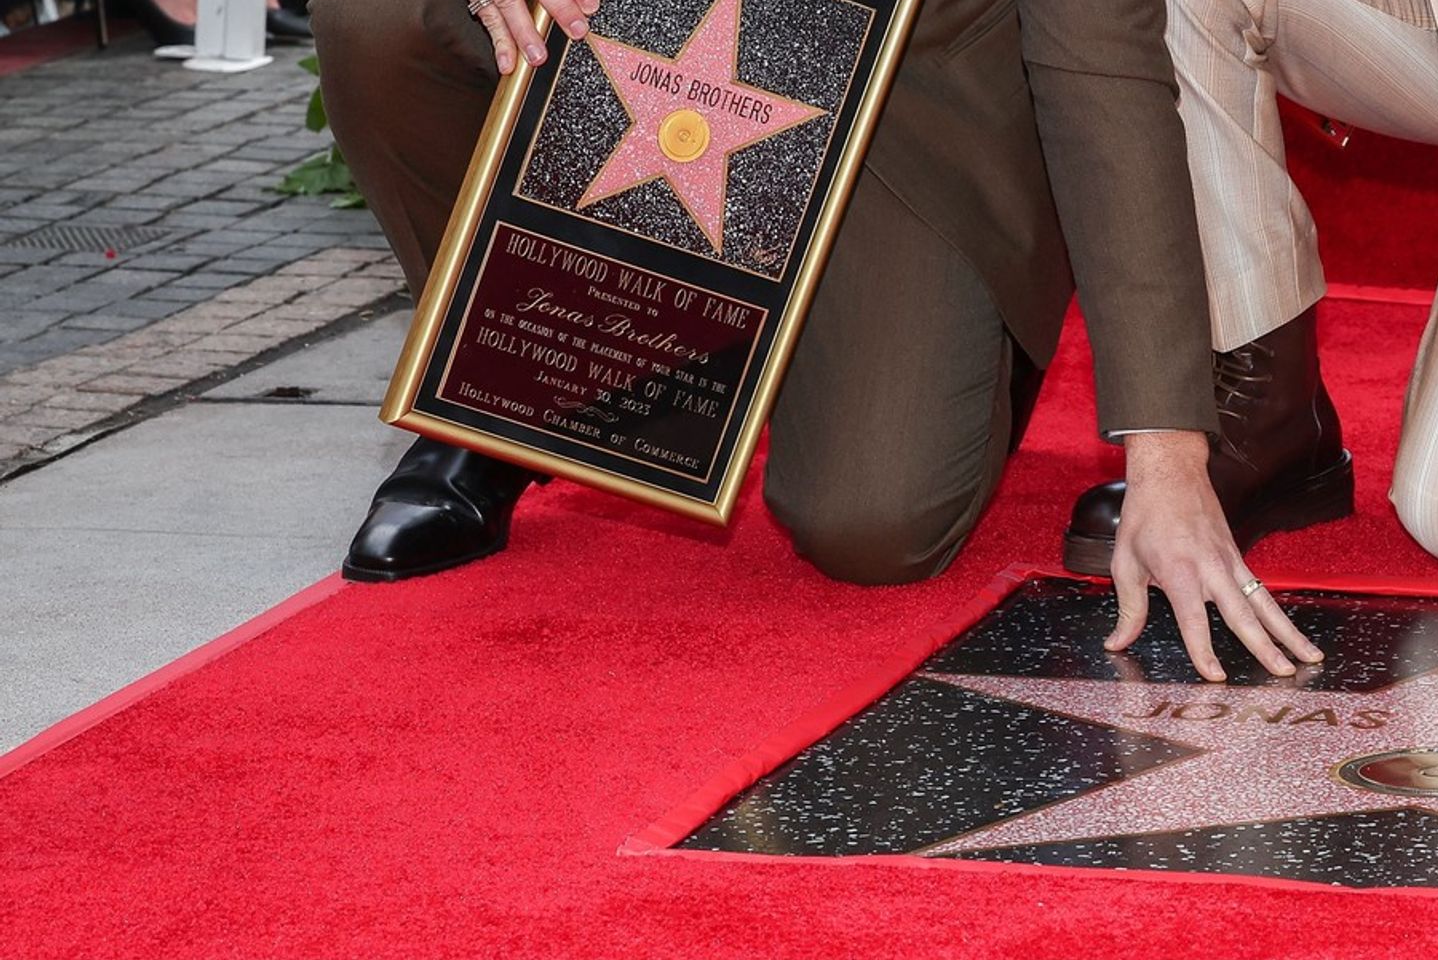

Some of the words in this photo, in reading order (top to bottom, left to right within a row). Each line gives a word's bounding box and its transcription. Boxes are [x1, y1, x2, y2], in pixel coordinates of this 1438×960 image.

[629, 62, 683, 95] JONAS
[687, 79, 773, 124] BROTHERS
[505, 232, 608, 283] HOLLYWOOD
[617, 268, 667, 304] WALK
[673, 288, 698, 312] OF
[702, 298, 750, 331] FAME
[587, 286, 641, 312] PRESENTED
[500, 313, 515, 326] THE
[518, 319, 555, 339] OCCASION
[557, 332, 569, 343] OF
[571, 336, 587, 350] THE
[590, 342, 633, 365] PLACEMENT
[635, 357, 647, 369] OF
[651, 361, 672, 377] YOUR
[675, 369, 696, 385] STAR
[711, 381, 727, 395] THE
[515, 287, 594, 327] Jonas
[598, 313, 710, 365] Brothers
[476, 326, 578, 373] HOLLYWOOD
[588, 361, 637, 392] WALK
[644, 380, 667, 400] OF
[673, 389, 719, 419] FAME
[534, 370, 588, 396] JANUARY
[619, 396, 652, 416] 2023
[458, 381, 535, 418] HOLLYWOOD
[543, 408, 601, 439] CHAMBER
[634, 437, 701, 470] COMMERCE
[1122, 700, 1389, 730] JONAS
